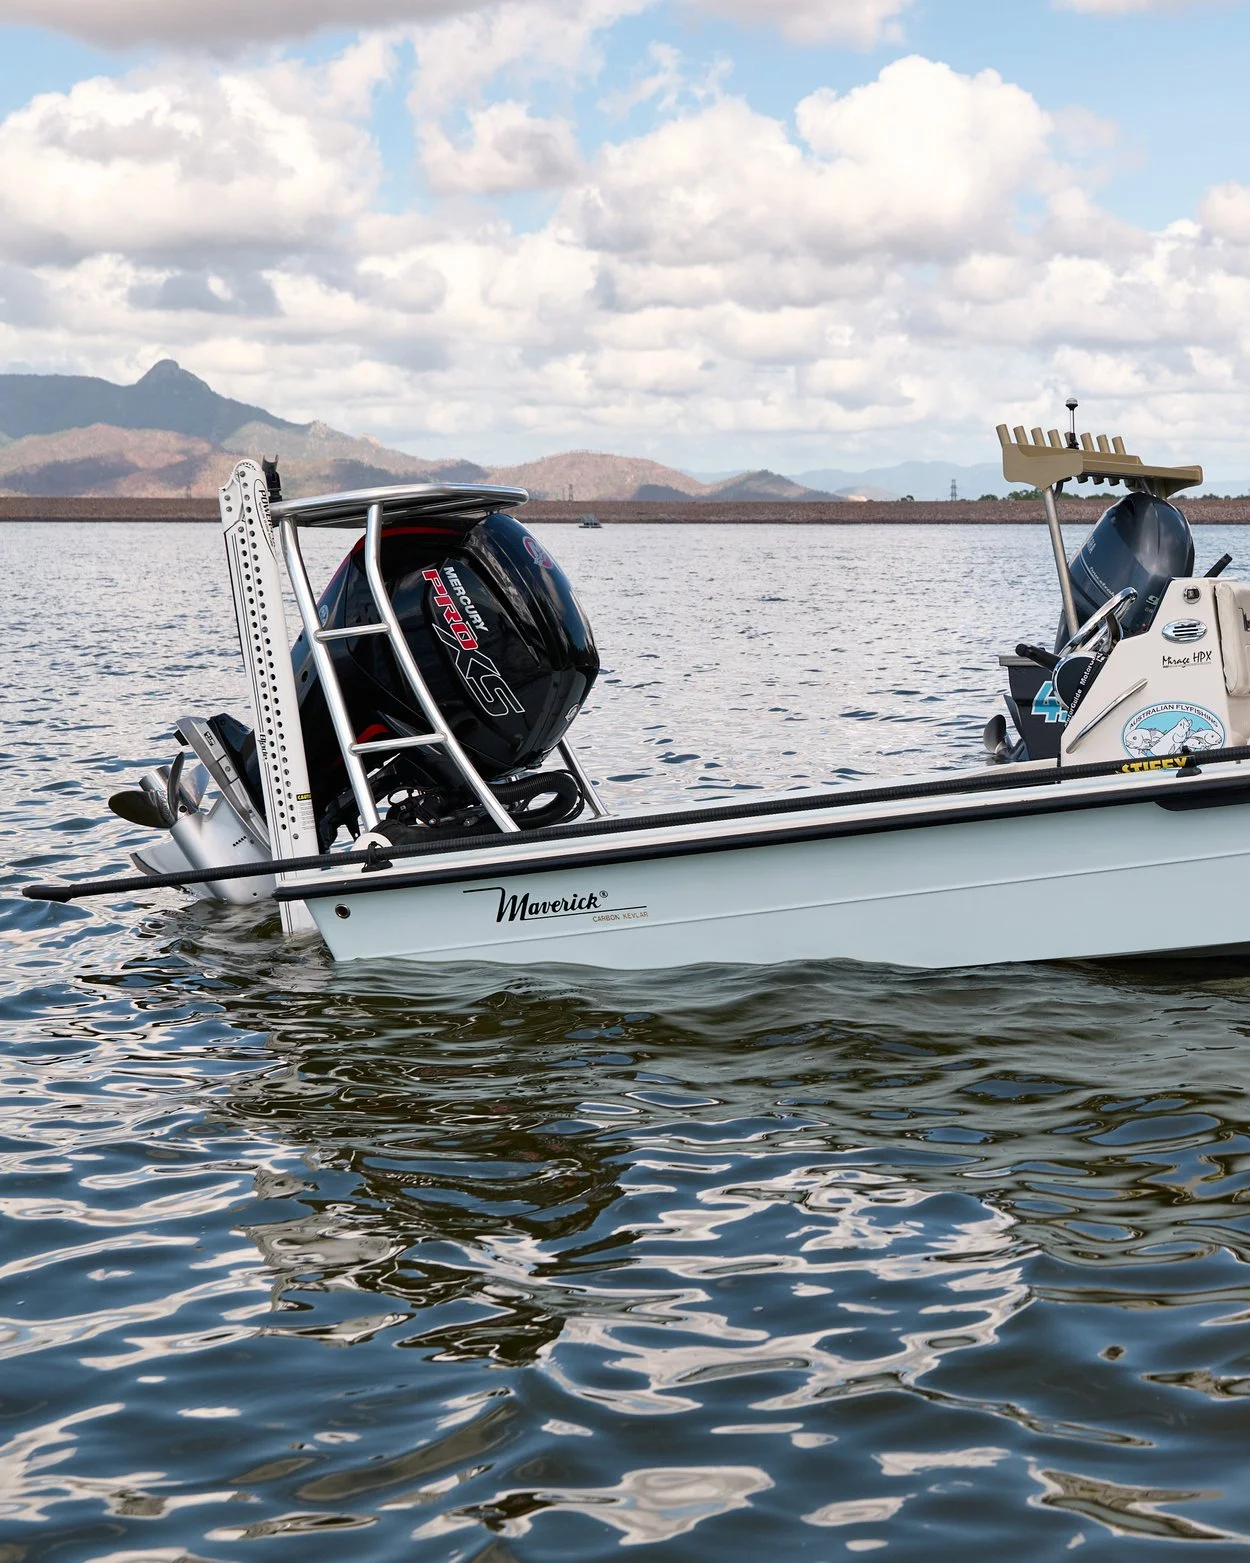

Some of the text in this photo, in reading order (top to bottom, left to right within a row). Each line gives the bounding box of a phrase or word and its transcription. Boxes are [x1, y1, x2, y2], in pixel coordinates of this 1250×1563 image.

[444, 566, 489, 632] MERCURY
[422, 569, 526, 717] PRO XS
[1162, 655, 1190, 668] Mirage
[1192, 650, 1213, 664] HPX
[1129, 704, 1219, 729] AUSTRALIAN FLYFISHING
[592, 911, 649, 923] CARBON KEVLAR
